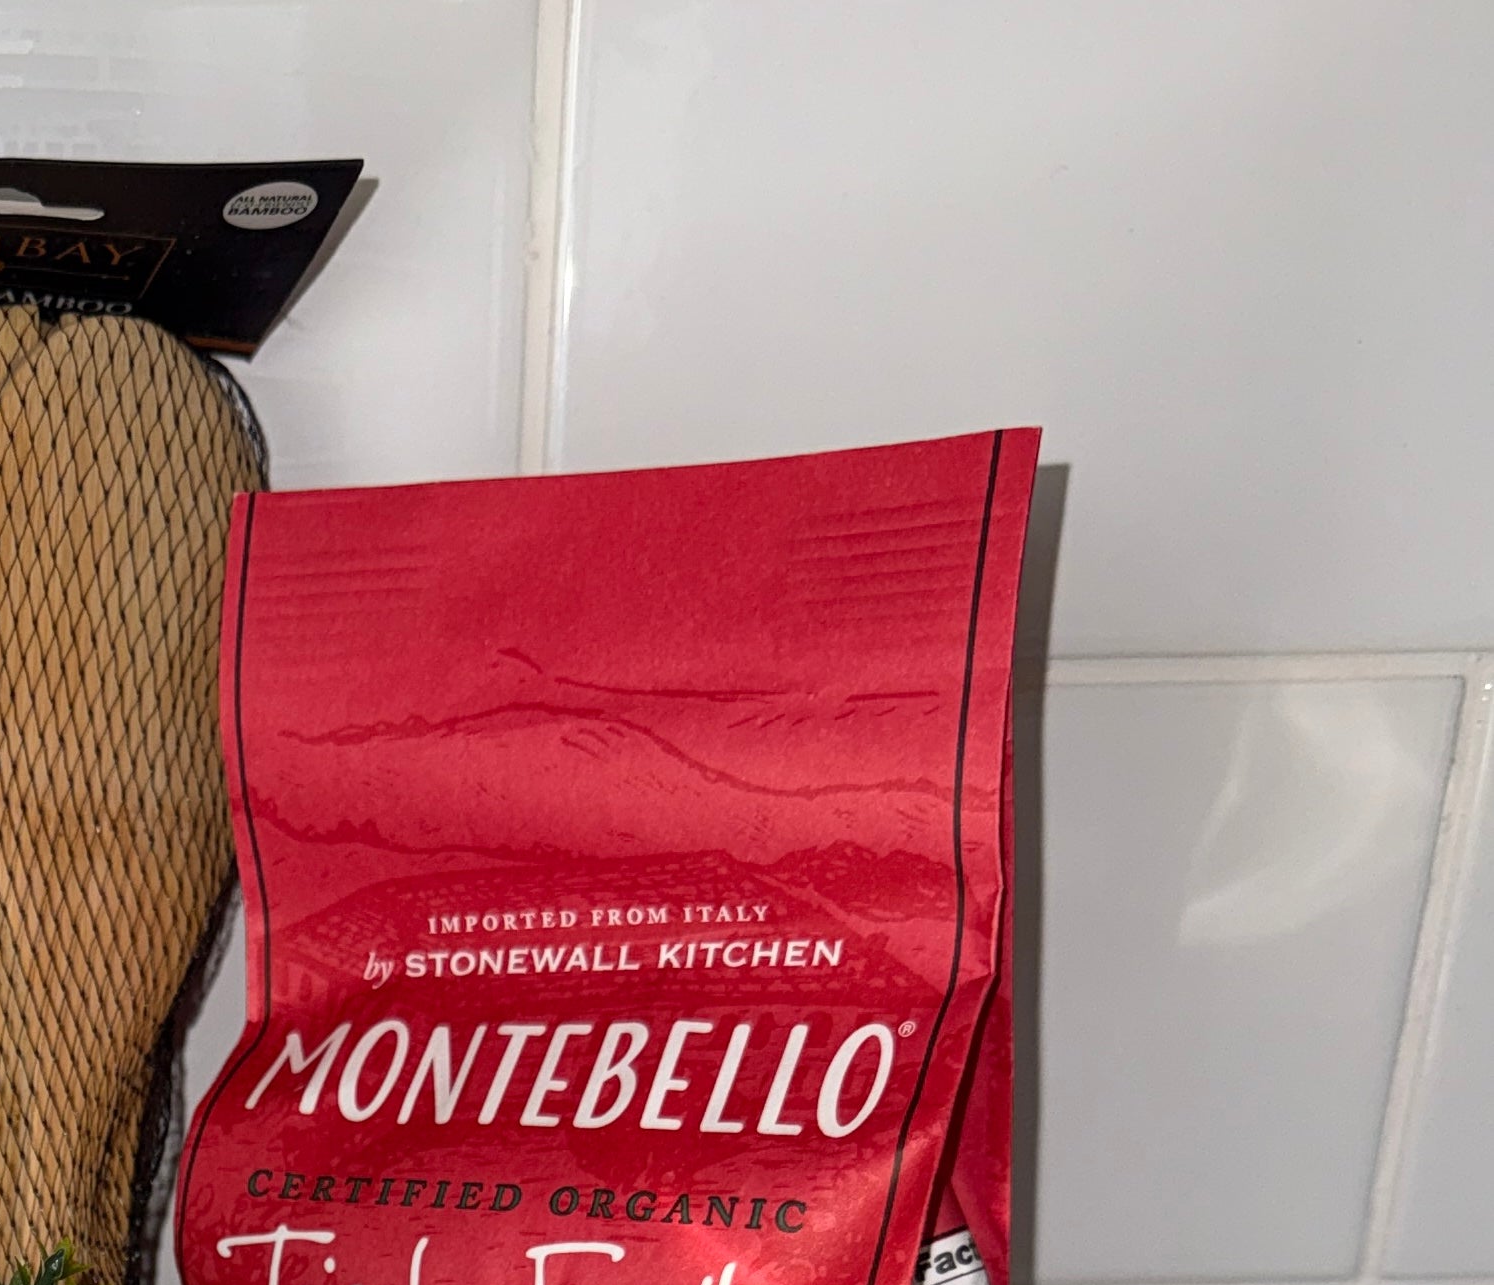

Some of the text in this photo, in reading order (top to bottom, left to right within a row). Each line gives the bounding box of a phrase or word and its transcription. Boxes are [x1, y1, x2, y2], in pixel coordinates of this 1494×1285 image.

[227, 207, 307, 216] BAMBOO
[427, 903, 771, 936] IMPORTED FROM ITALY
[362, 938, 845, 989] by STONEWALL KITCHEN
[244, 1019, 895, 1140] MONTEBELLO
[246, 1168, 809, 1236] CERTIFIED ORGANIC
